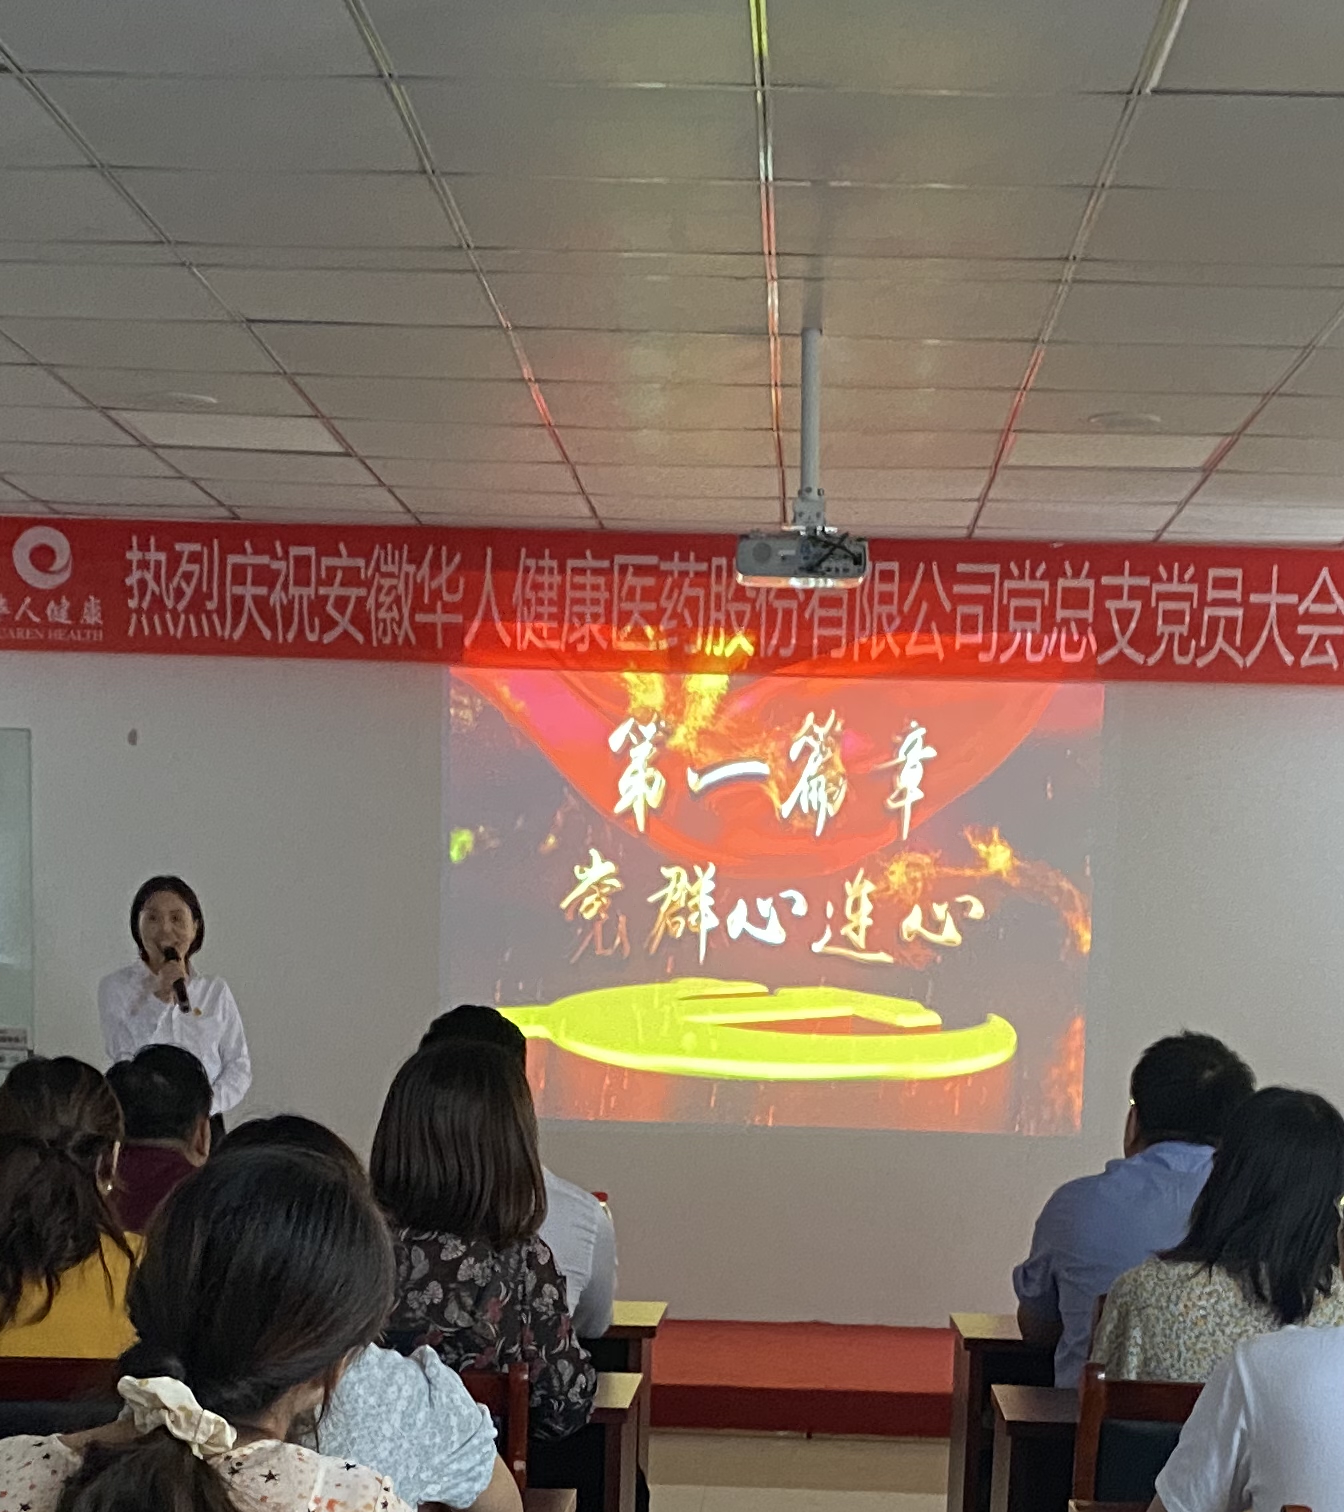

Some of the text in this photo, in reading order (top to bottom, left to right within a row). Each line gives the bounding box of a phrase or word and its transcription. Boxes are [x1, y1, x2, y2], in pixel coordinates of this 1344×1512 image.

[48, 628, 103, 641] HEALTH
[608, 708, 939, 840] 第一篇章
[560, 848, 986, 964] 党群心连心
